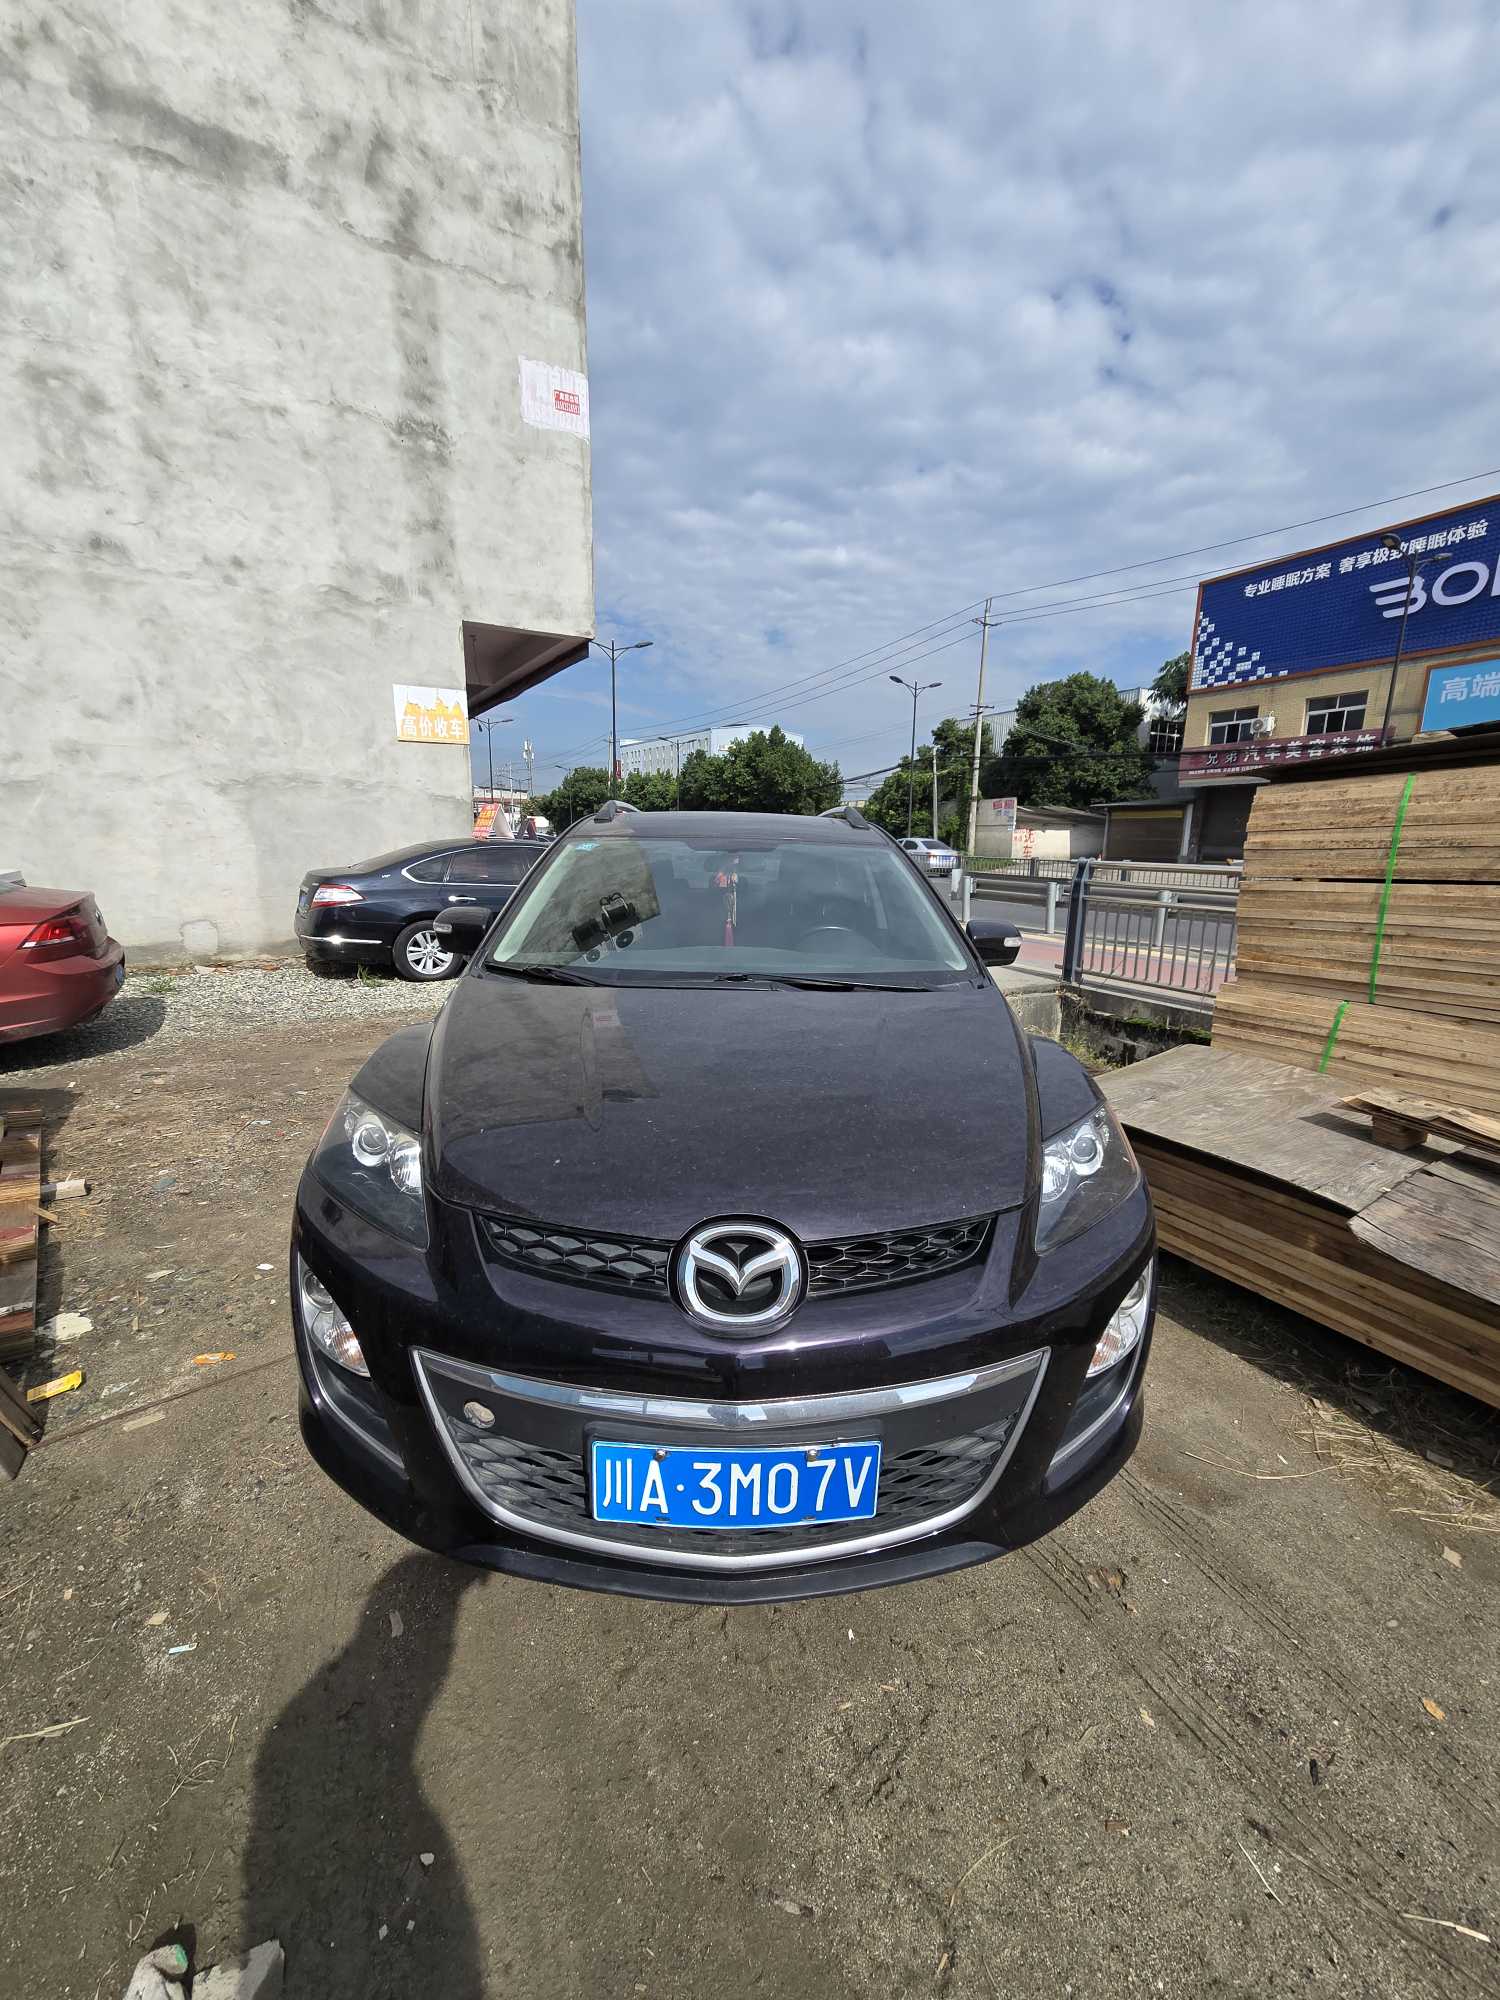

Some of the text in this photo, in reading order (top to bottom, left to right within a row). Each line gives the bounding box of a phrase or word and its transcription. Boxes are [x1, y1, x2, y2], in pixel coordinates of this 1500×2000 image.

[1244, 519, 1489, 598] 专业睡眠方案 奢享极致睡眠体验
[1369, 553, 1500, 619] BO
[1440, 671, 1500, 704] 高端
[401, 715, 464, 740] 高价收车
